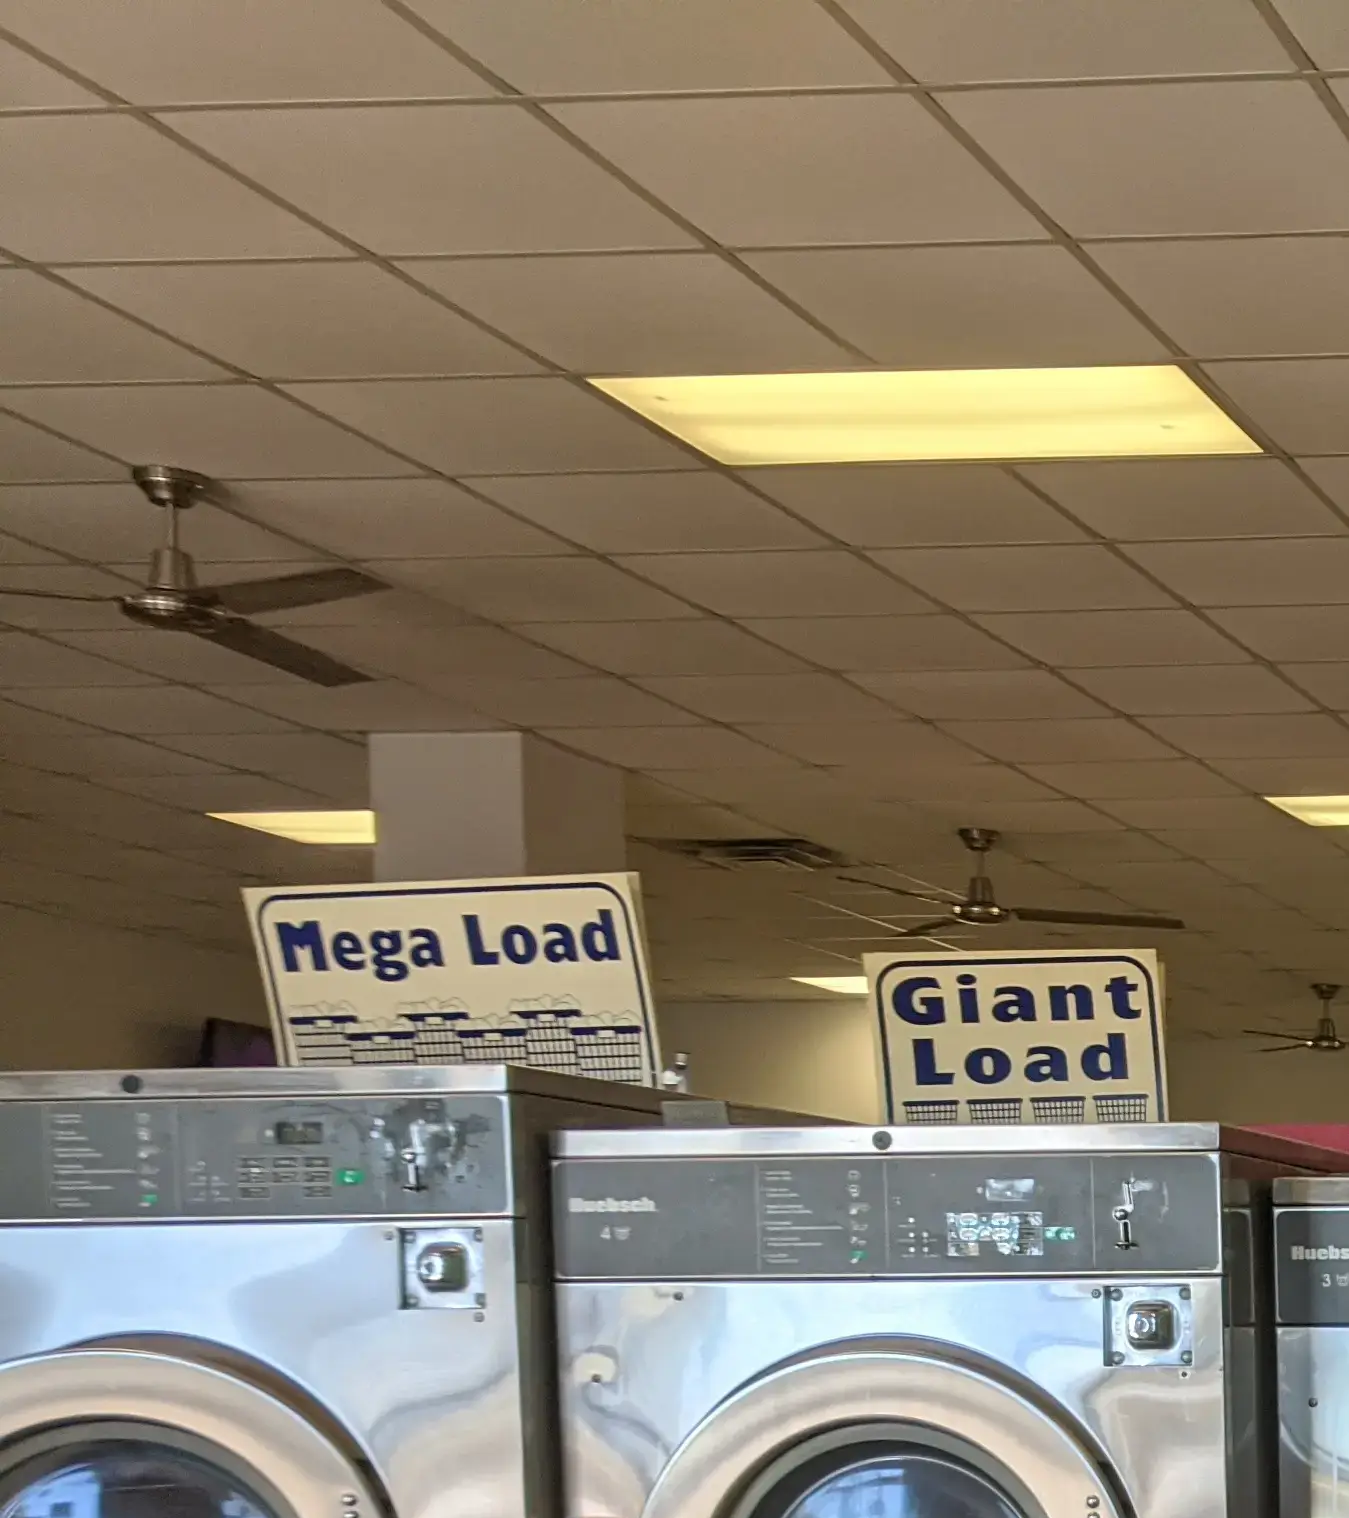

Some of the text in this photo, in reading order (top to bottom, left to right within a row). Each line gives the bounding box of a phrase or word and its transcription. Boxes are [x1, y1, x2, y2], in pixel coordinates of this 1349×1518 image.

[274, 908, 621, 982] Mega Load
[892, 973, 1142, 1026] Giant
[913, 1032, 1130, 1086] Load
[1322, 1273, 1332, 1288] 3
